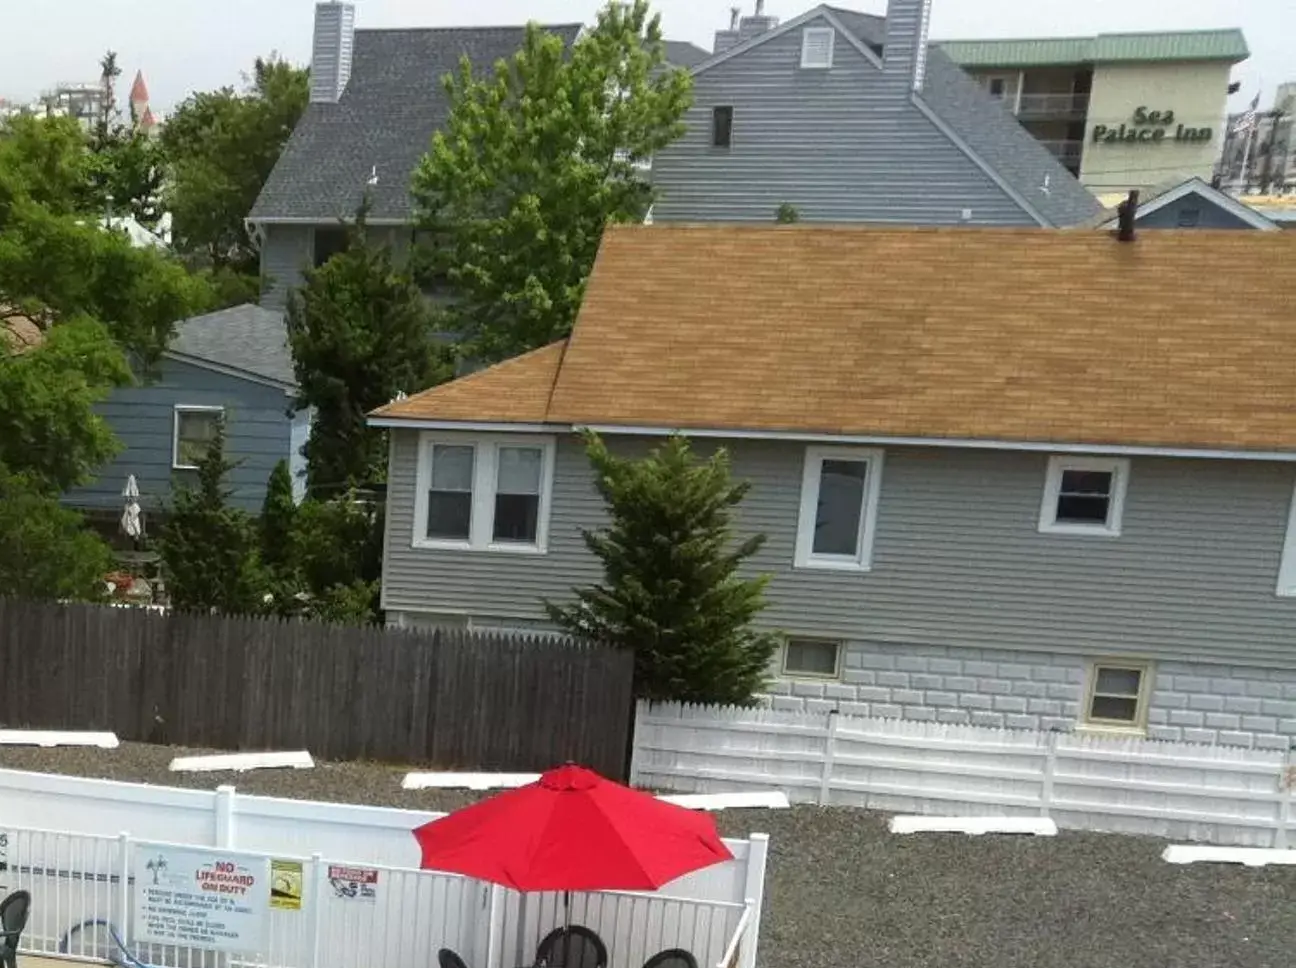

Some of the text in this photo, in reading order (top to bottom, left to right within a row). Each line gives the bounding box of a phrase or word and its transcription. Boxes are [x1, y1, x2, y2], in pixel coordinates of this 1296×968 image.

[1133, 106, 1174, 125] Sea
[1093, 124, 1212, 142] Palace Inn
[215, 861, 235, 873] NO
[195, 869, 255, 886] LIFEGUARD
[202, 882, 246, 895] ON DUTY
